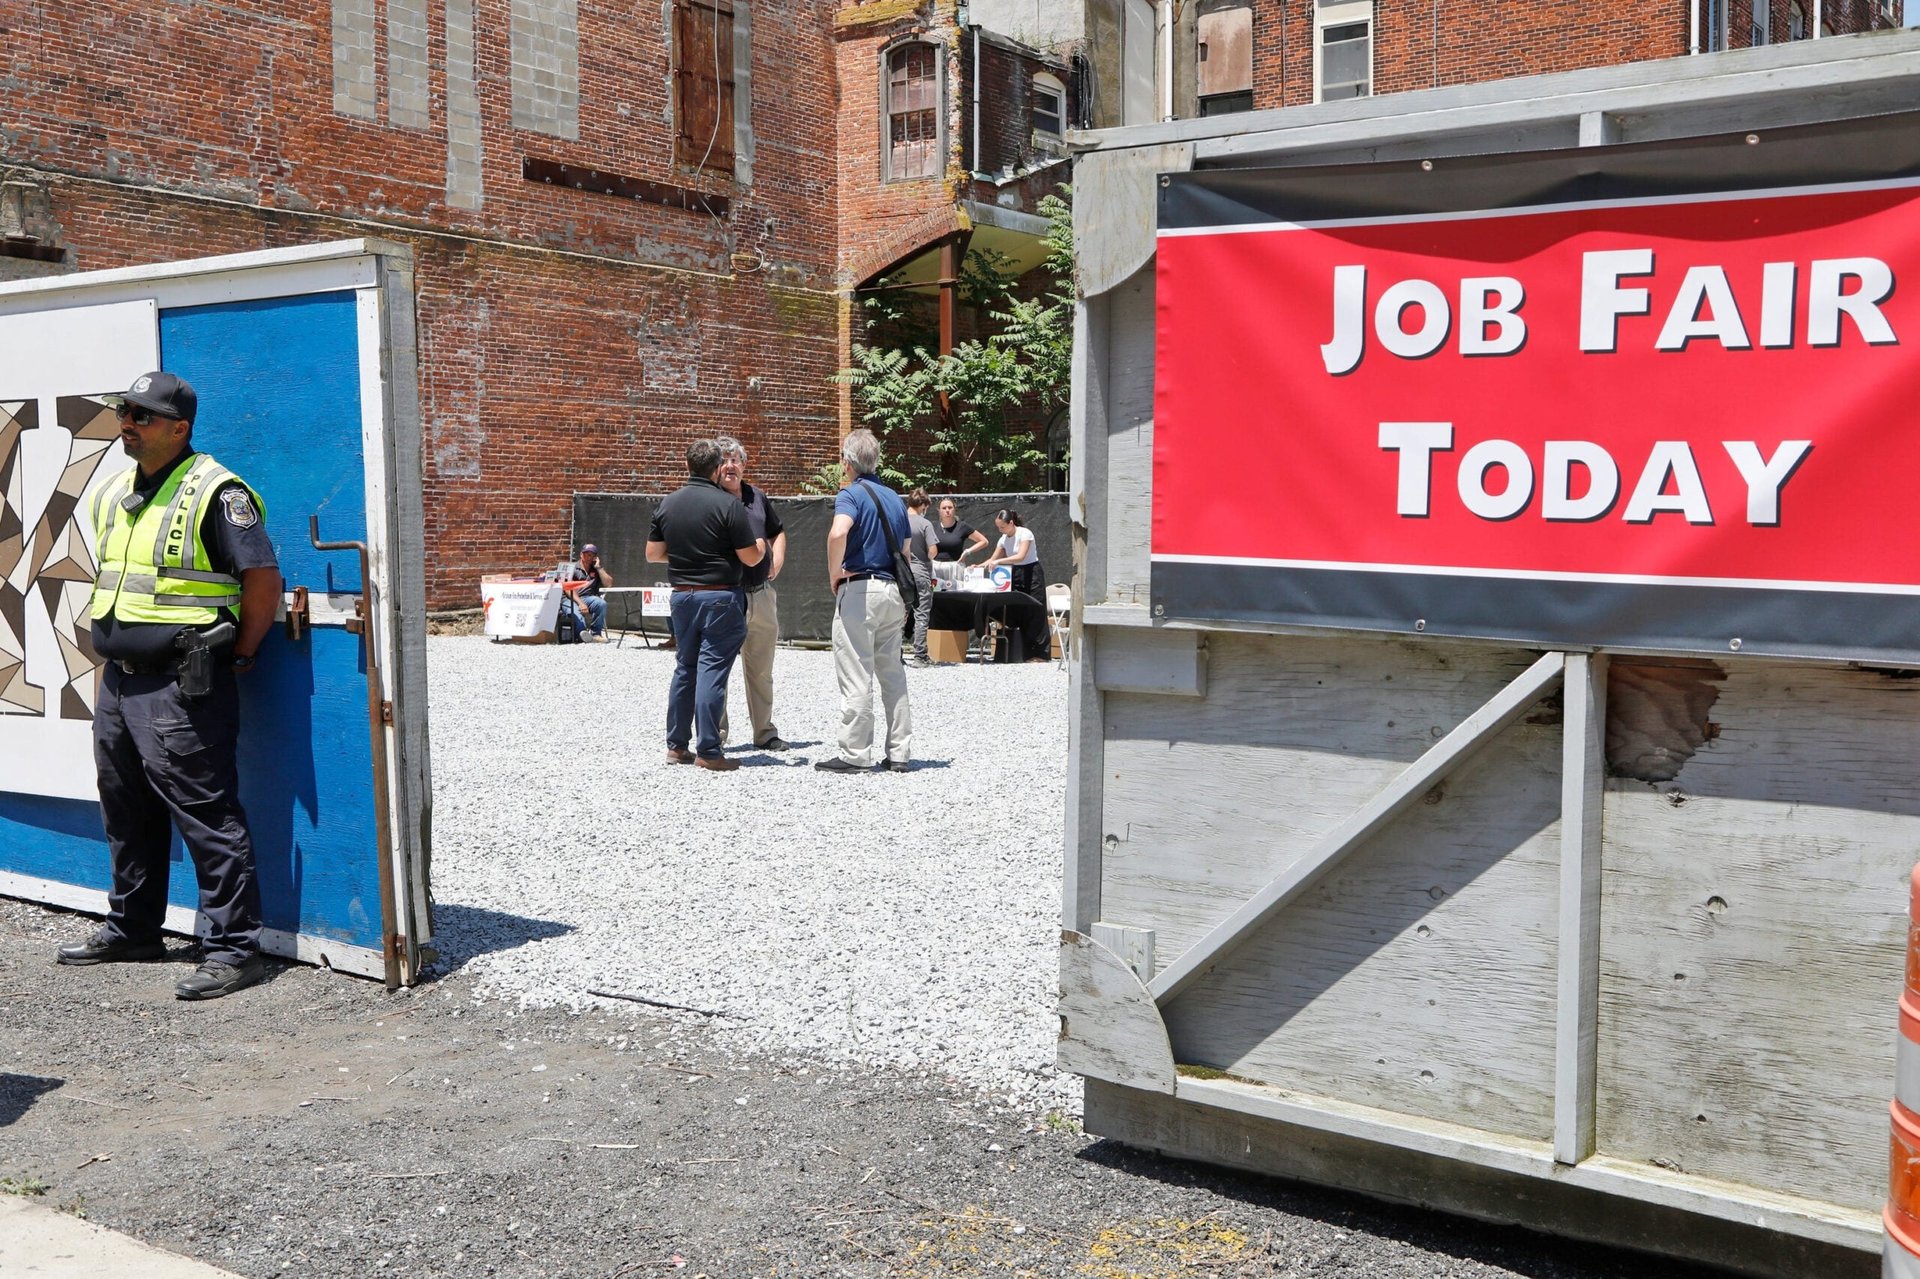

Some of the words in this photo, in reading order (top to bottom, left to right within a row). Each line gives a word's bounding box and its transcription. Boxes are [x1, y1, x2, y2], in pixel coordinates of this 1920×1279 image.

[1320, 264, 1527, 374] JOB
[1579, 248, 1898, 353] FAIR
[167, 474, 201, 556] POLICE
[1377, 421, 1814, 526] TODAY
